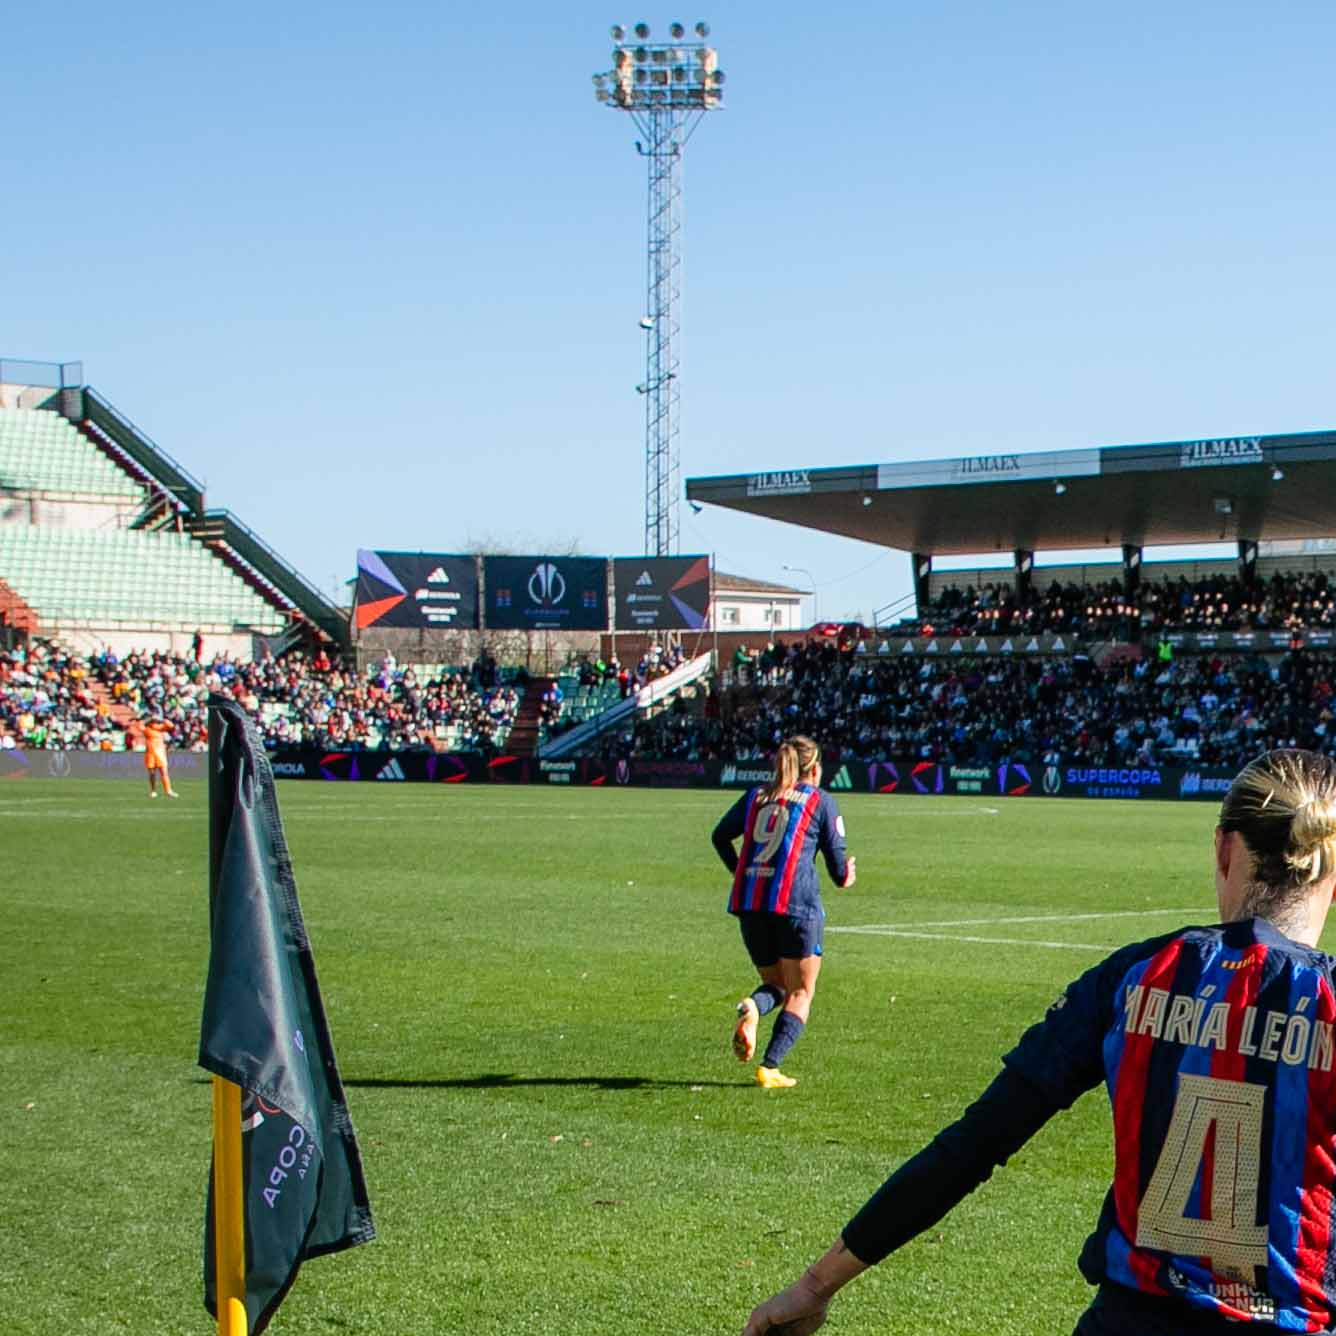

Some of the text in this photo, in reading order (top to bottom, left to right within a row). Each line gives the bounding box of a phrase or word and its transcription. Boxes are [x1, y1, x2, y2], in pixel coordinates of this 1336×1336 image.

[1066, 768, 1161, 785] SUPERCOPA
[753, 802, 789, 863] 9
[1238, 996, 1334, 1072] LEÓN
[1134, 1072, 1269, 1284] 4
